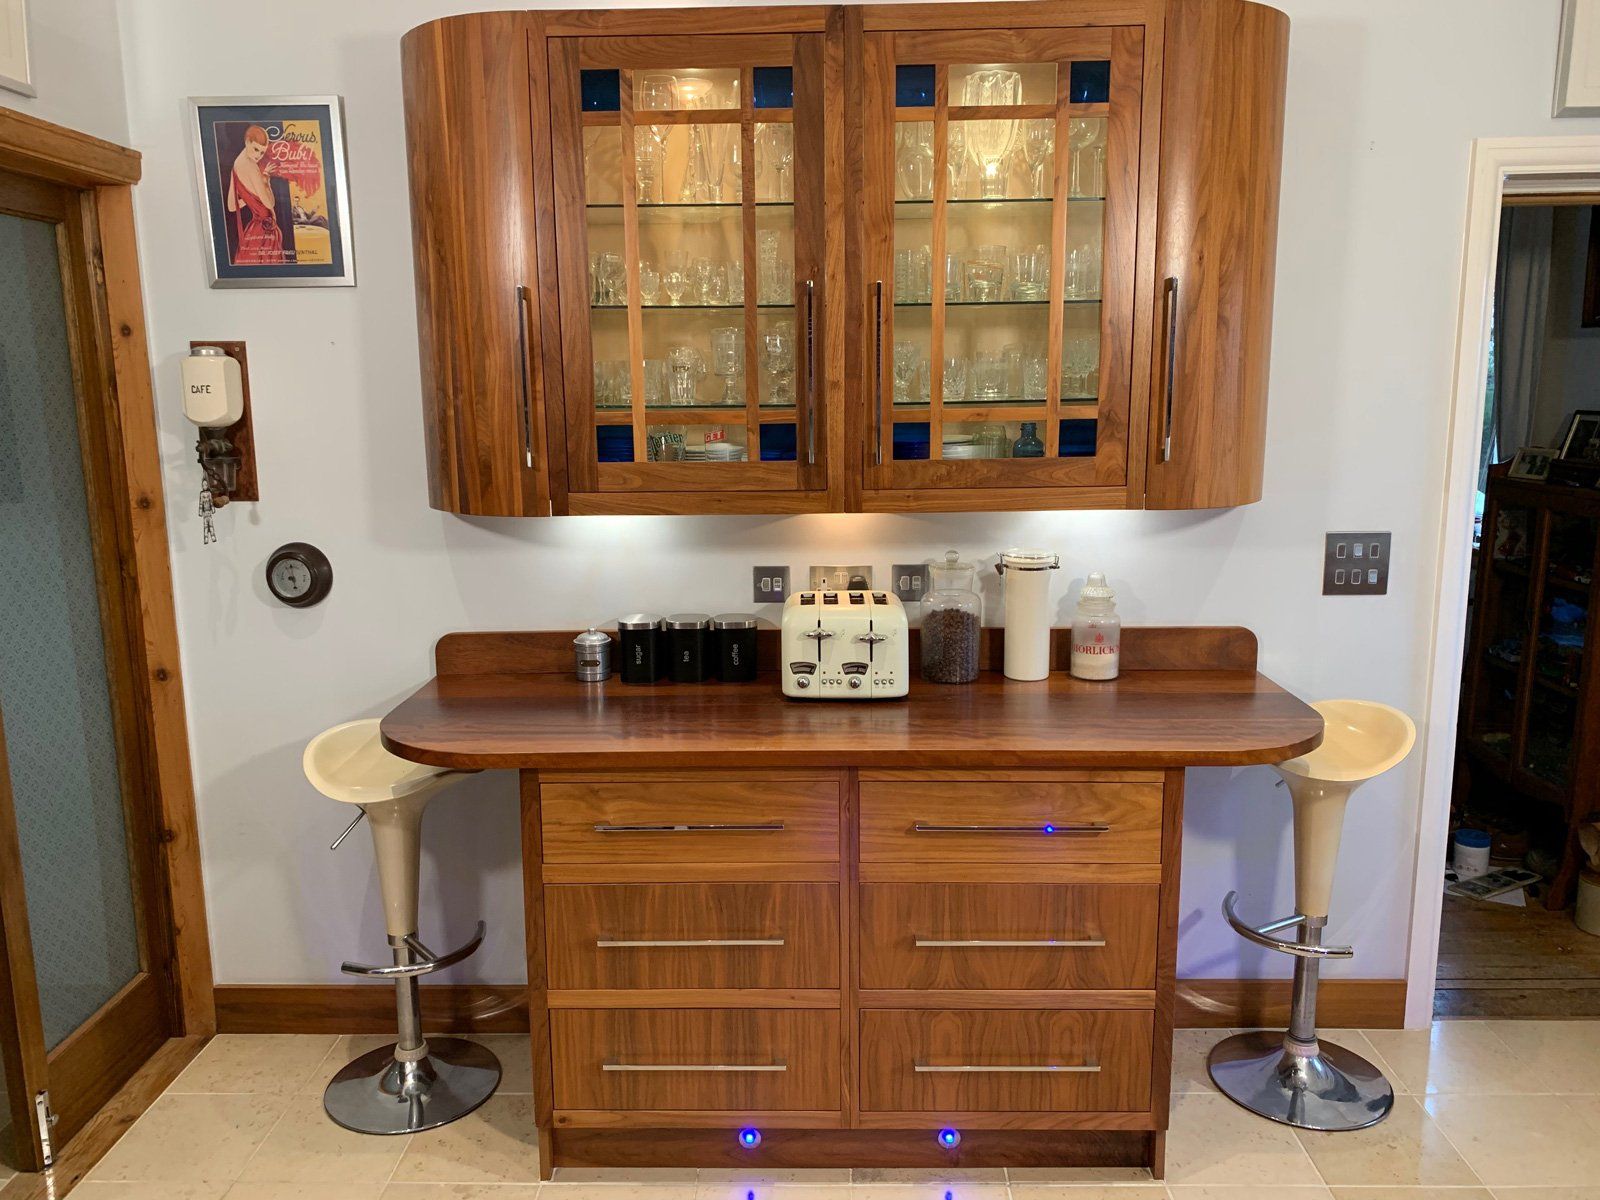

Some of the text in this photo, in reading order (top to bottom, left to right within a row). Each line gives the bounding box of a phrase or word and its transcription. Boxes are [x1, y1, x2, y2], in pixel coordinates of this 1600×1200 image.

[272, 140, 313, 161] Bubi!
[191, 385, 212, 394] CAFE
[705, 431, 722, 442] GET
[732, 644, 740, 666] coffee
